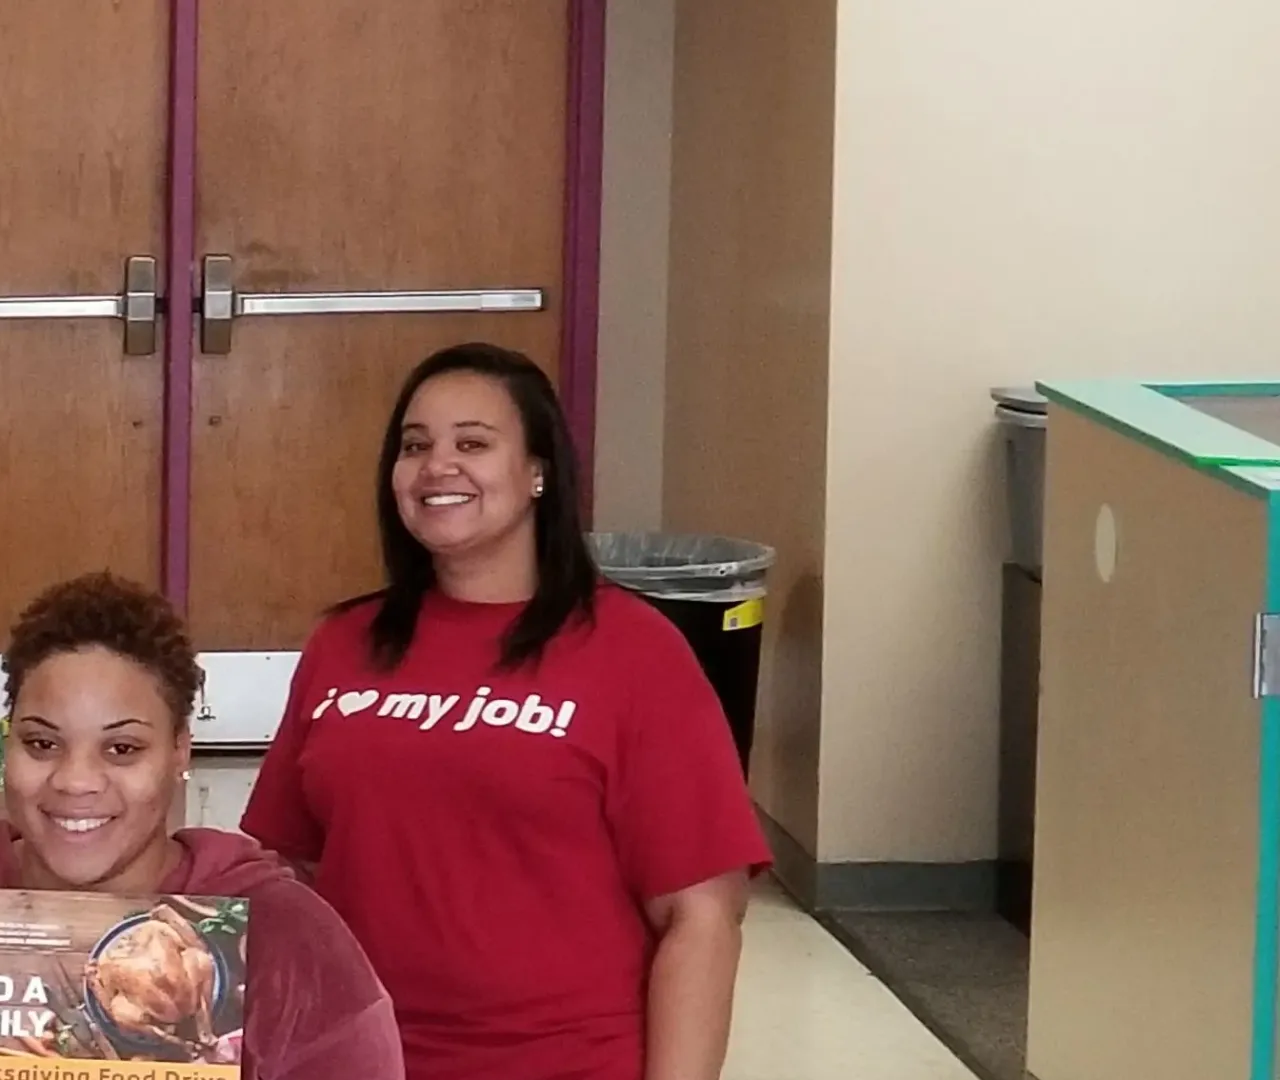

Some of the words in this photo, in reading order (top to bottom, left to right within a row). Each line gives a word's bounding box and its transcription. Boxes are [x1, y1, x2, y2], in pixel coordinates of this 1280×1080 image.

[312, 687, 339, 720] i
[376, 692, 460, 732] my
[453, 685, 577, 738] job!
[23, 976, 48, 1004] A
